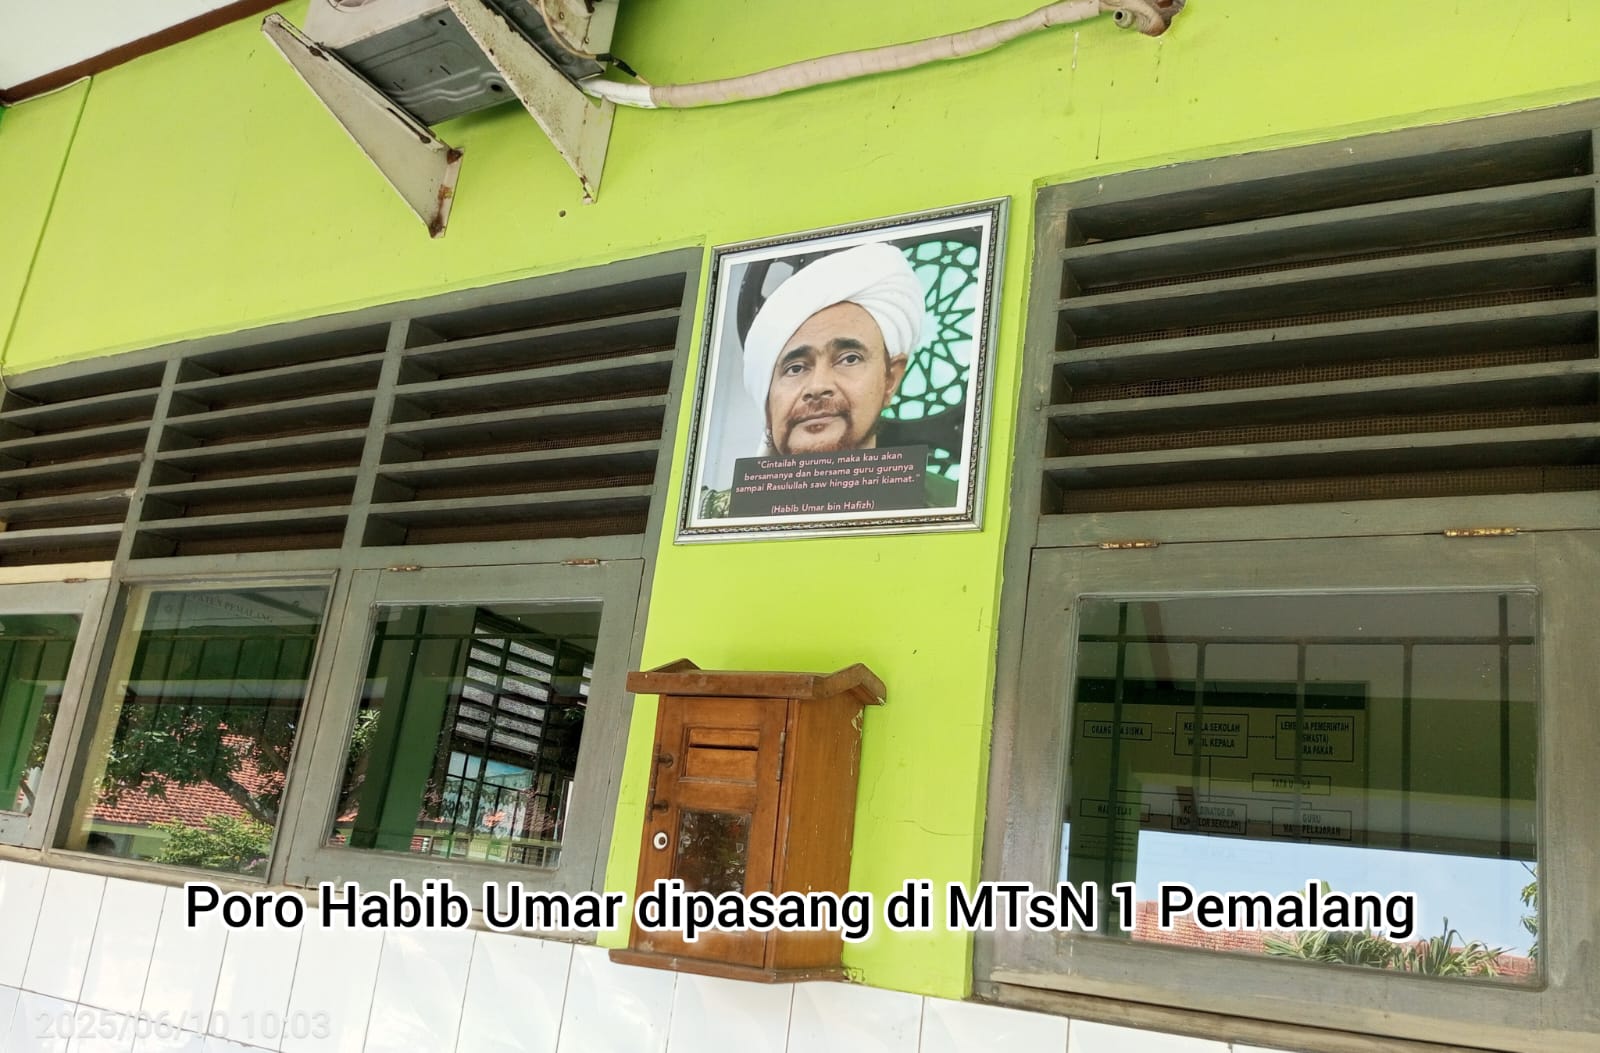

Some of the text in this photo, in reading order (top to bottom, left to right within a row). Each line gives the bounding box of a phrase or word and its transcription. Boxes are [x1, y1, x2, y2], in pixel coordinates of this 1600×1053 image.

[799, 457, 835, 468] gurumu,
[837, 455, 861, 464] maka
[863, 453, 879, 462] kau
[881, 452, 903, 461] akan
[744, 464, 914, 481] bersamanya dan bersama guru gurunya
[735, 483, 765, 494] sampai
[766, 481, 808, 491] Rasulullah
[810, 480, 827, 488] saw
[829, 478, 860, 489] hingga
[862, 477, 879, 485] hari
[771, 499, 875, 515] (Habib Umar bin Hafizh)
